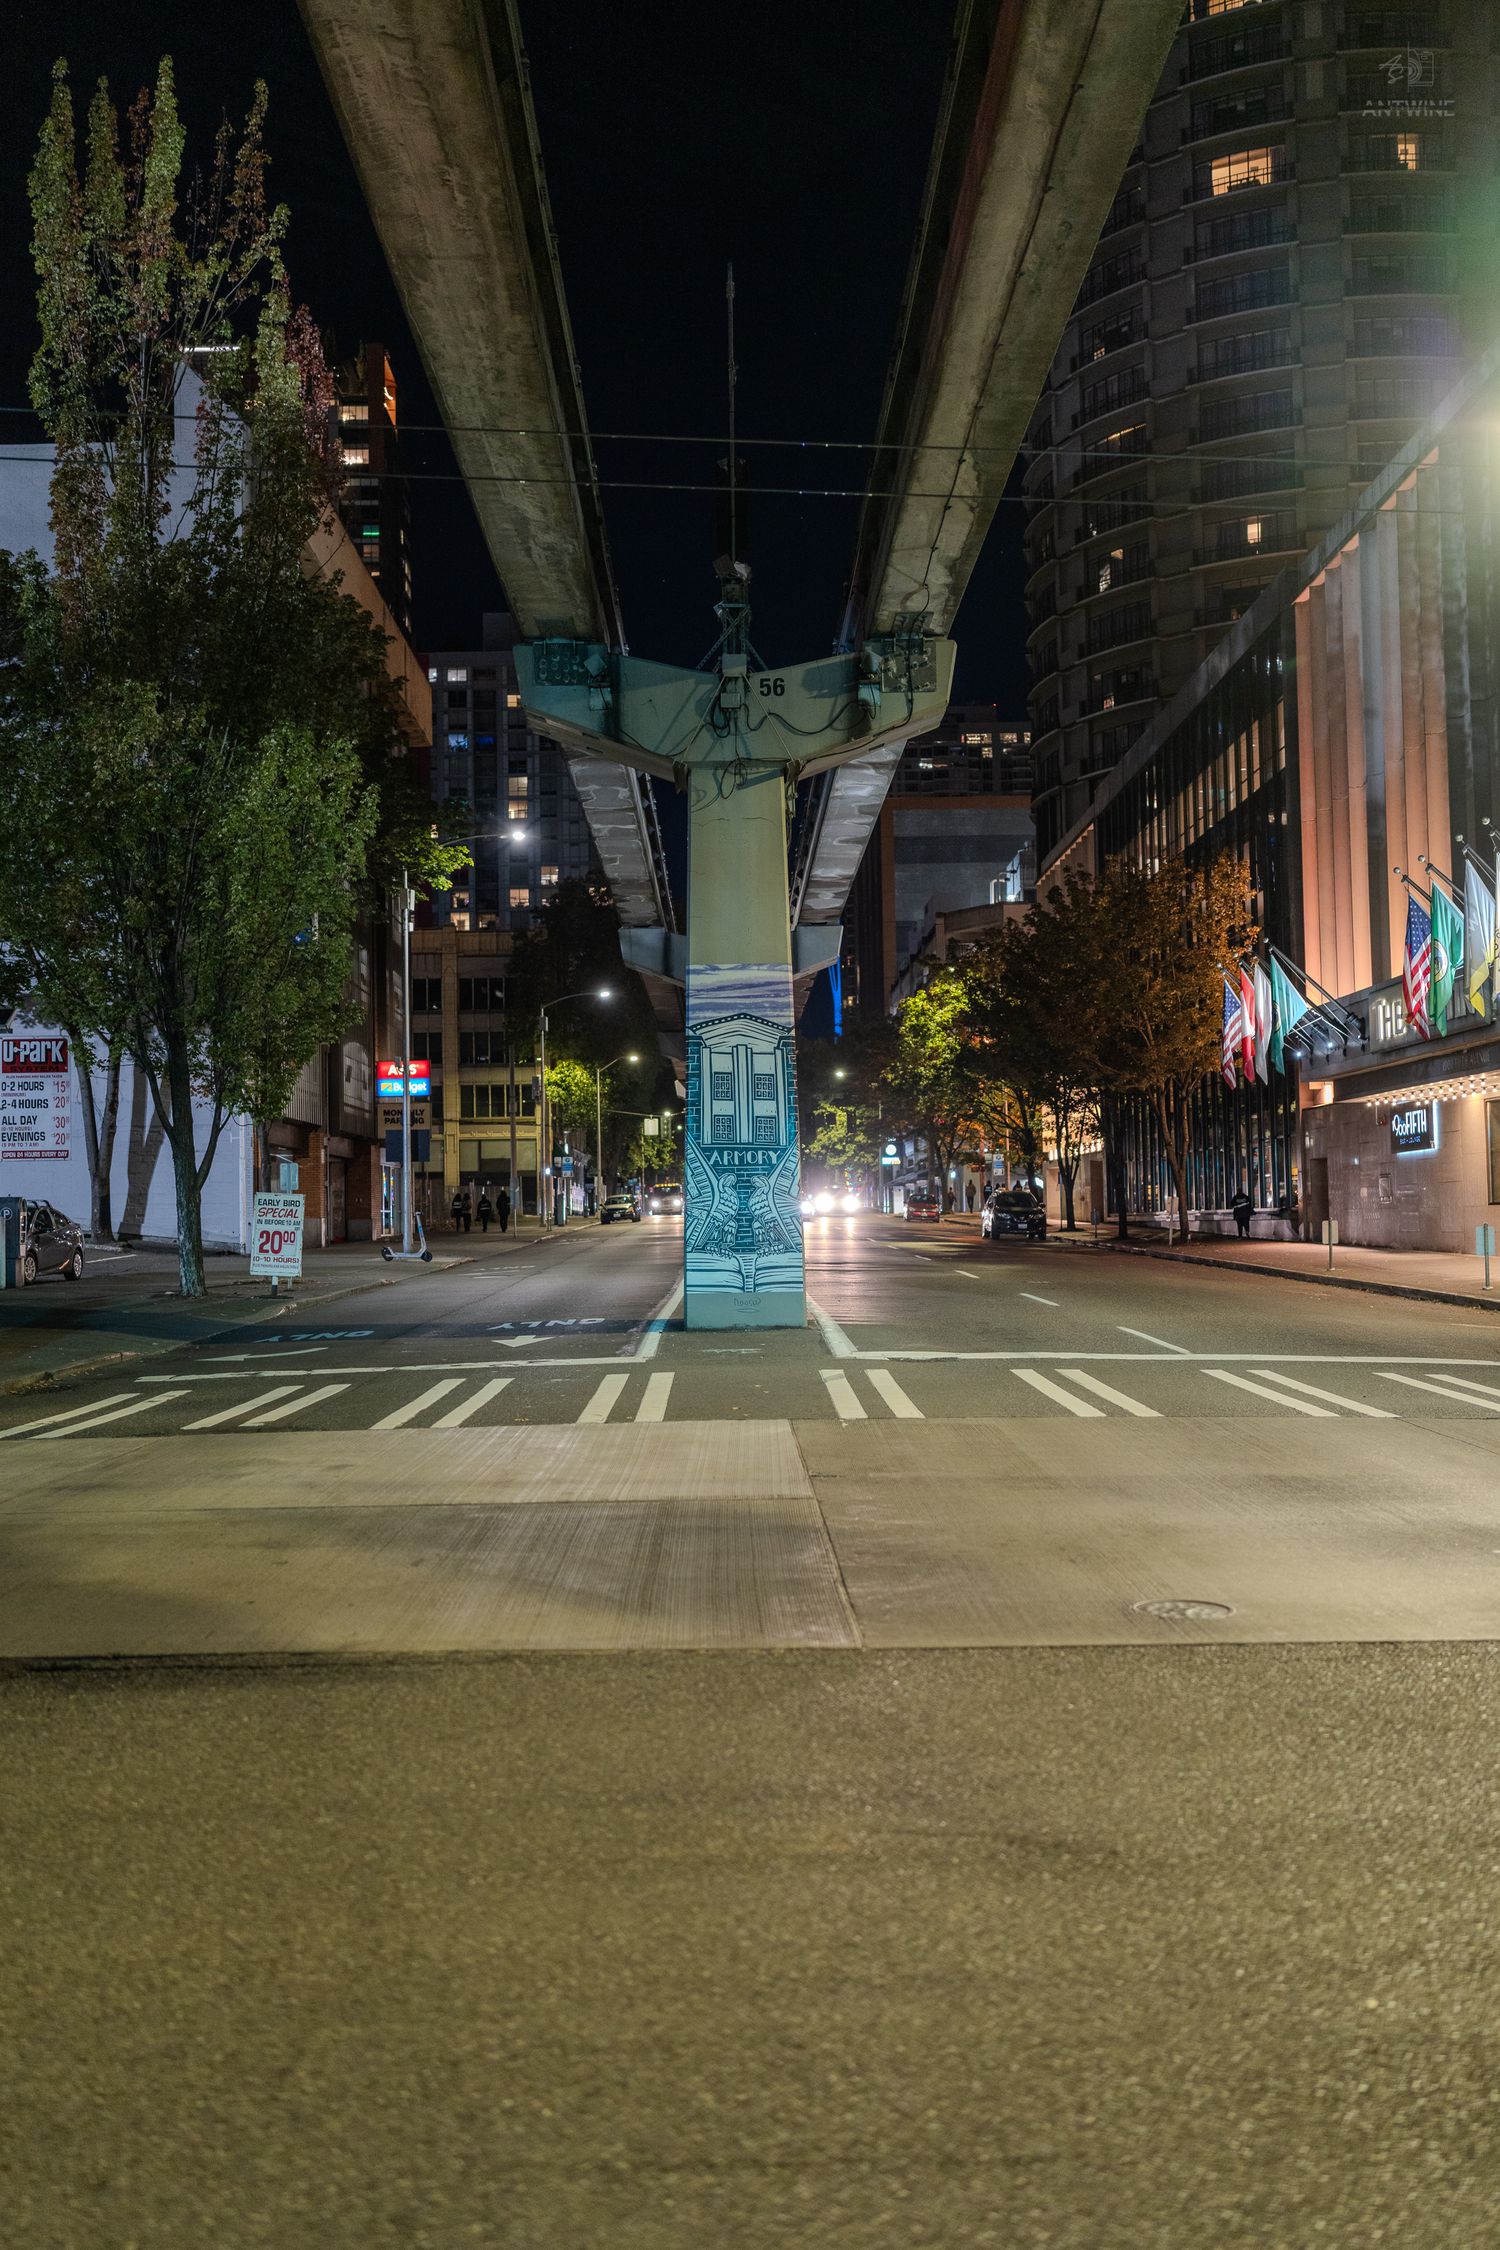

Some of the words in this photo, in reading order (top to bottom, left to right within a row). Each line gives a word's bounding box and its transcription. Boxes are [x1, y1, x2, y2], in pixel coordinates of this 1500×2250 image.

[760, 677, 785, 696] 56
[1371, 998, 1407, 1041] THE
[388, 1063, 417, 1076] AS
[1, 1081, 15, 1091] 0-2
[18, 1081, 45, 1091] HOURS
[1, 1099, 17, 1109] 2-4
[19, 1098, 49, 1109] HOURS
[2, 1115, 17, 1125] ALL
[20, 1115, 38, 1125] DAY
[2, 1131, 46, 1142] EVENINGS
[709, 1149, 781, 1166] ARMORY
[258, 1198, 281, 1207] EARLY
[283, 1199, 301, 1207] BIRD
[257, 1207, 299, 1219] SPECIAL
[273, 1256, 300, 1264] HOURS)
